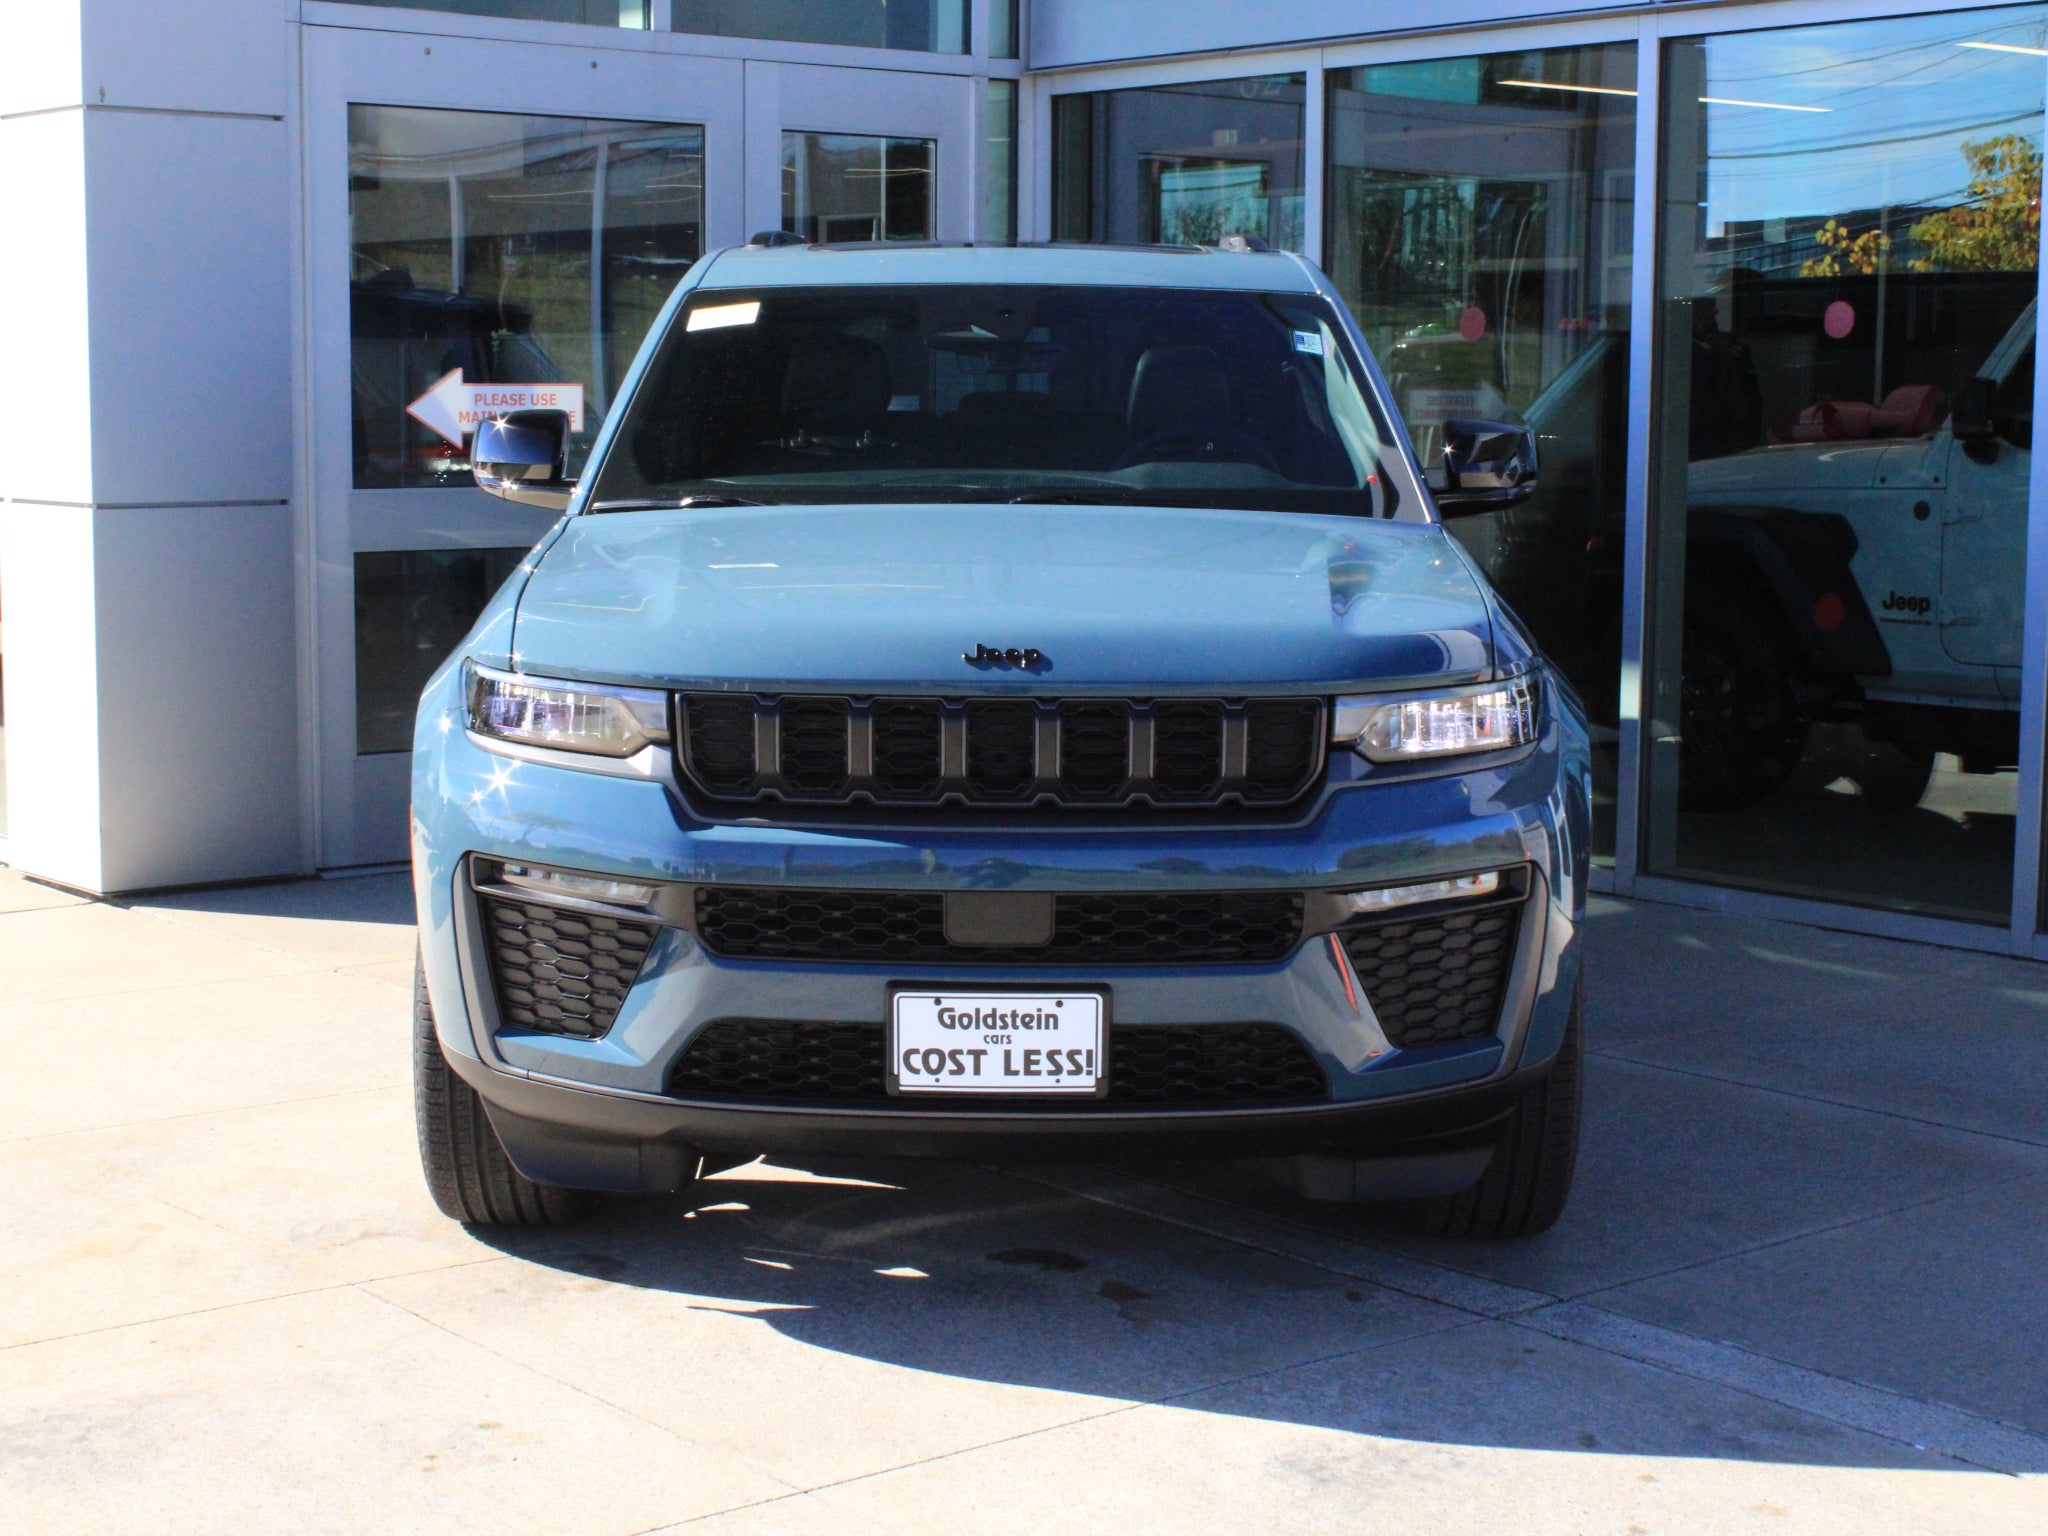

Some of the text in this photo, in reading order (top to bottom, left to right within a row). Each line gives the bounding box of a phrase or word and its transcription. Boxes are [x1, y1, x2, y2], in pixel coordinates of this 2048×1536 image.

[474, 393, 557, 406] PLEASE USE
[1882, 590, 1931, 616] Jeep
[962, 643, 1041, 670] Jeep
[937, 1007, 1059, 1031] Goldstein
[983, 1034, 1012, 1045] cars
[902, 1048, 1094, 1076] COST LESS!
